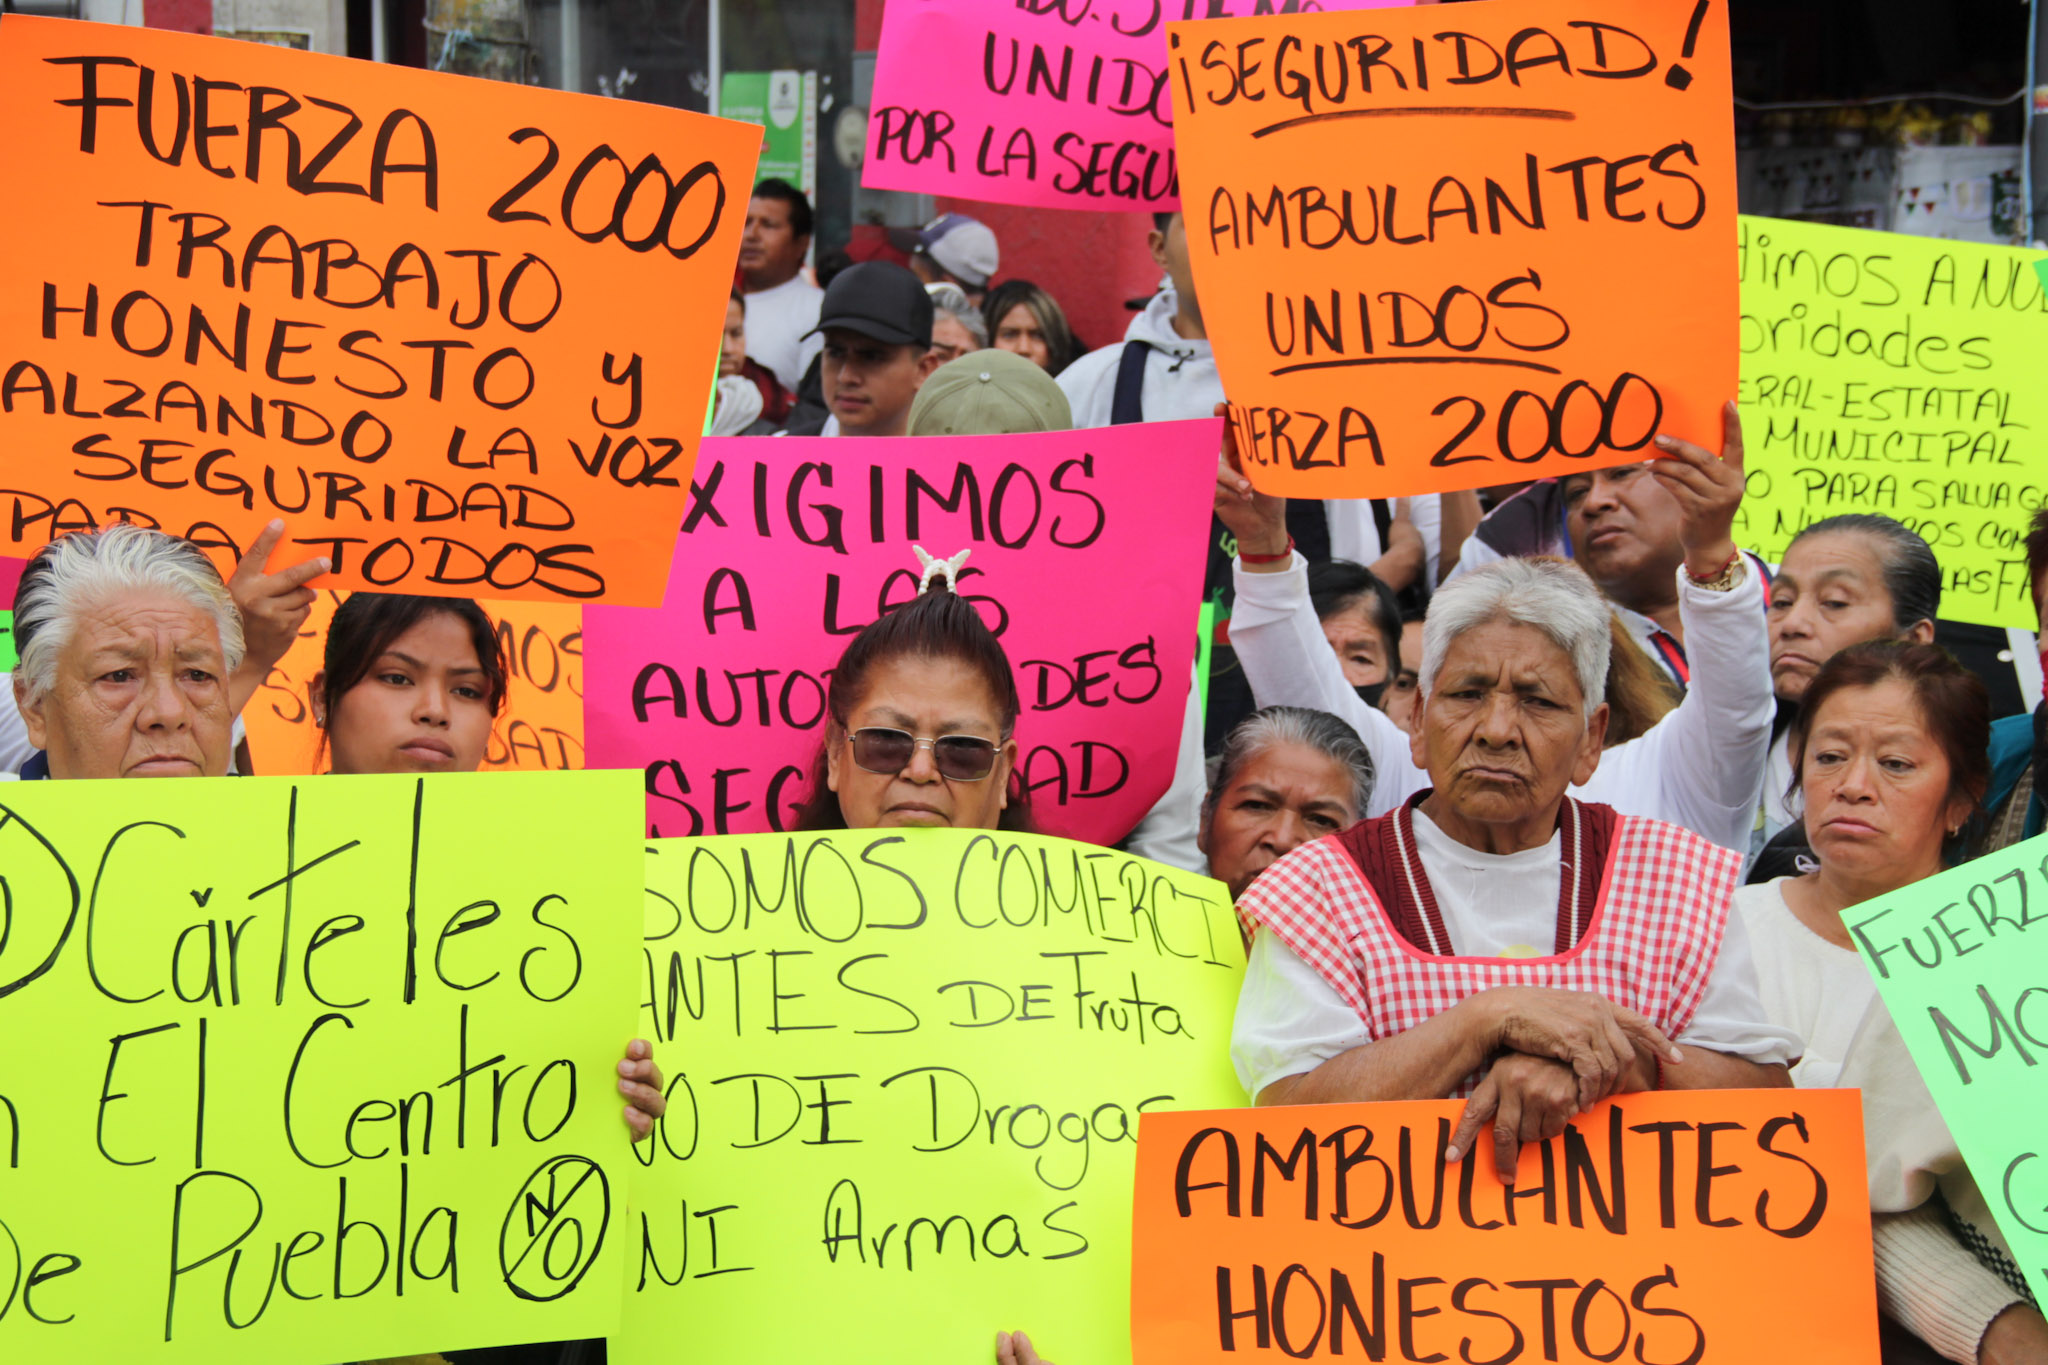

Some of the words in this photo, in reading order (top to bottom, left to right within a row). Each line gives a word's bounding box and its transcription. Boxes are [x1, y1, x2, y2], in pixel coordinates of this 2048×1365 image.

[42, 56, 438, 211] FUERZA
[487, 127, 726, 259] 2000
[874, 107, 955, 173] POR
[976, 125, 1037, 181] LA
[1209, 140, 1705, 255] AMBULANTES
[97, 201, 562, 332] TRABAJO
[1266, 268, 1569, 356] UNIDOS
[1924, 253, 1955, 306] A
[41, 282, 535, 410] HONESTO
[2, 360, 393, 464] ALZANDO
[448, 426, 538, 474] LA
[567, 434, 684, 488] VOZ
[1431, 372, 1663, 467] 2000
[1764, 417, 2024, 467] MUNICIPAL
[72, 433, 574, 532] SEGURIDAD
[1793, 468, 1896, 508] PARA
[292, 537, 605, 597] TODOS
[702, 567, 757, 635] A
[937, 980, 1056, 1027] DE
[1039, 951, 1195, 1045] Fruta
[97, 1017, 206, 1169] El
[284, 1005, 577, 1169] Centro
[710, 1073, 864, 1150] DE
[1174, 1104, 1828, 1239] AMBULANTES
[165, 1163, 458, 1342] Puebla
[636, 1199, 755, 1293] NI
[1216, 1251, 1705, 1365] HONESTOS
